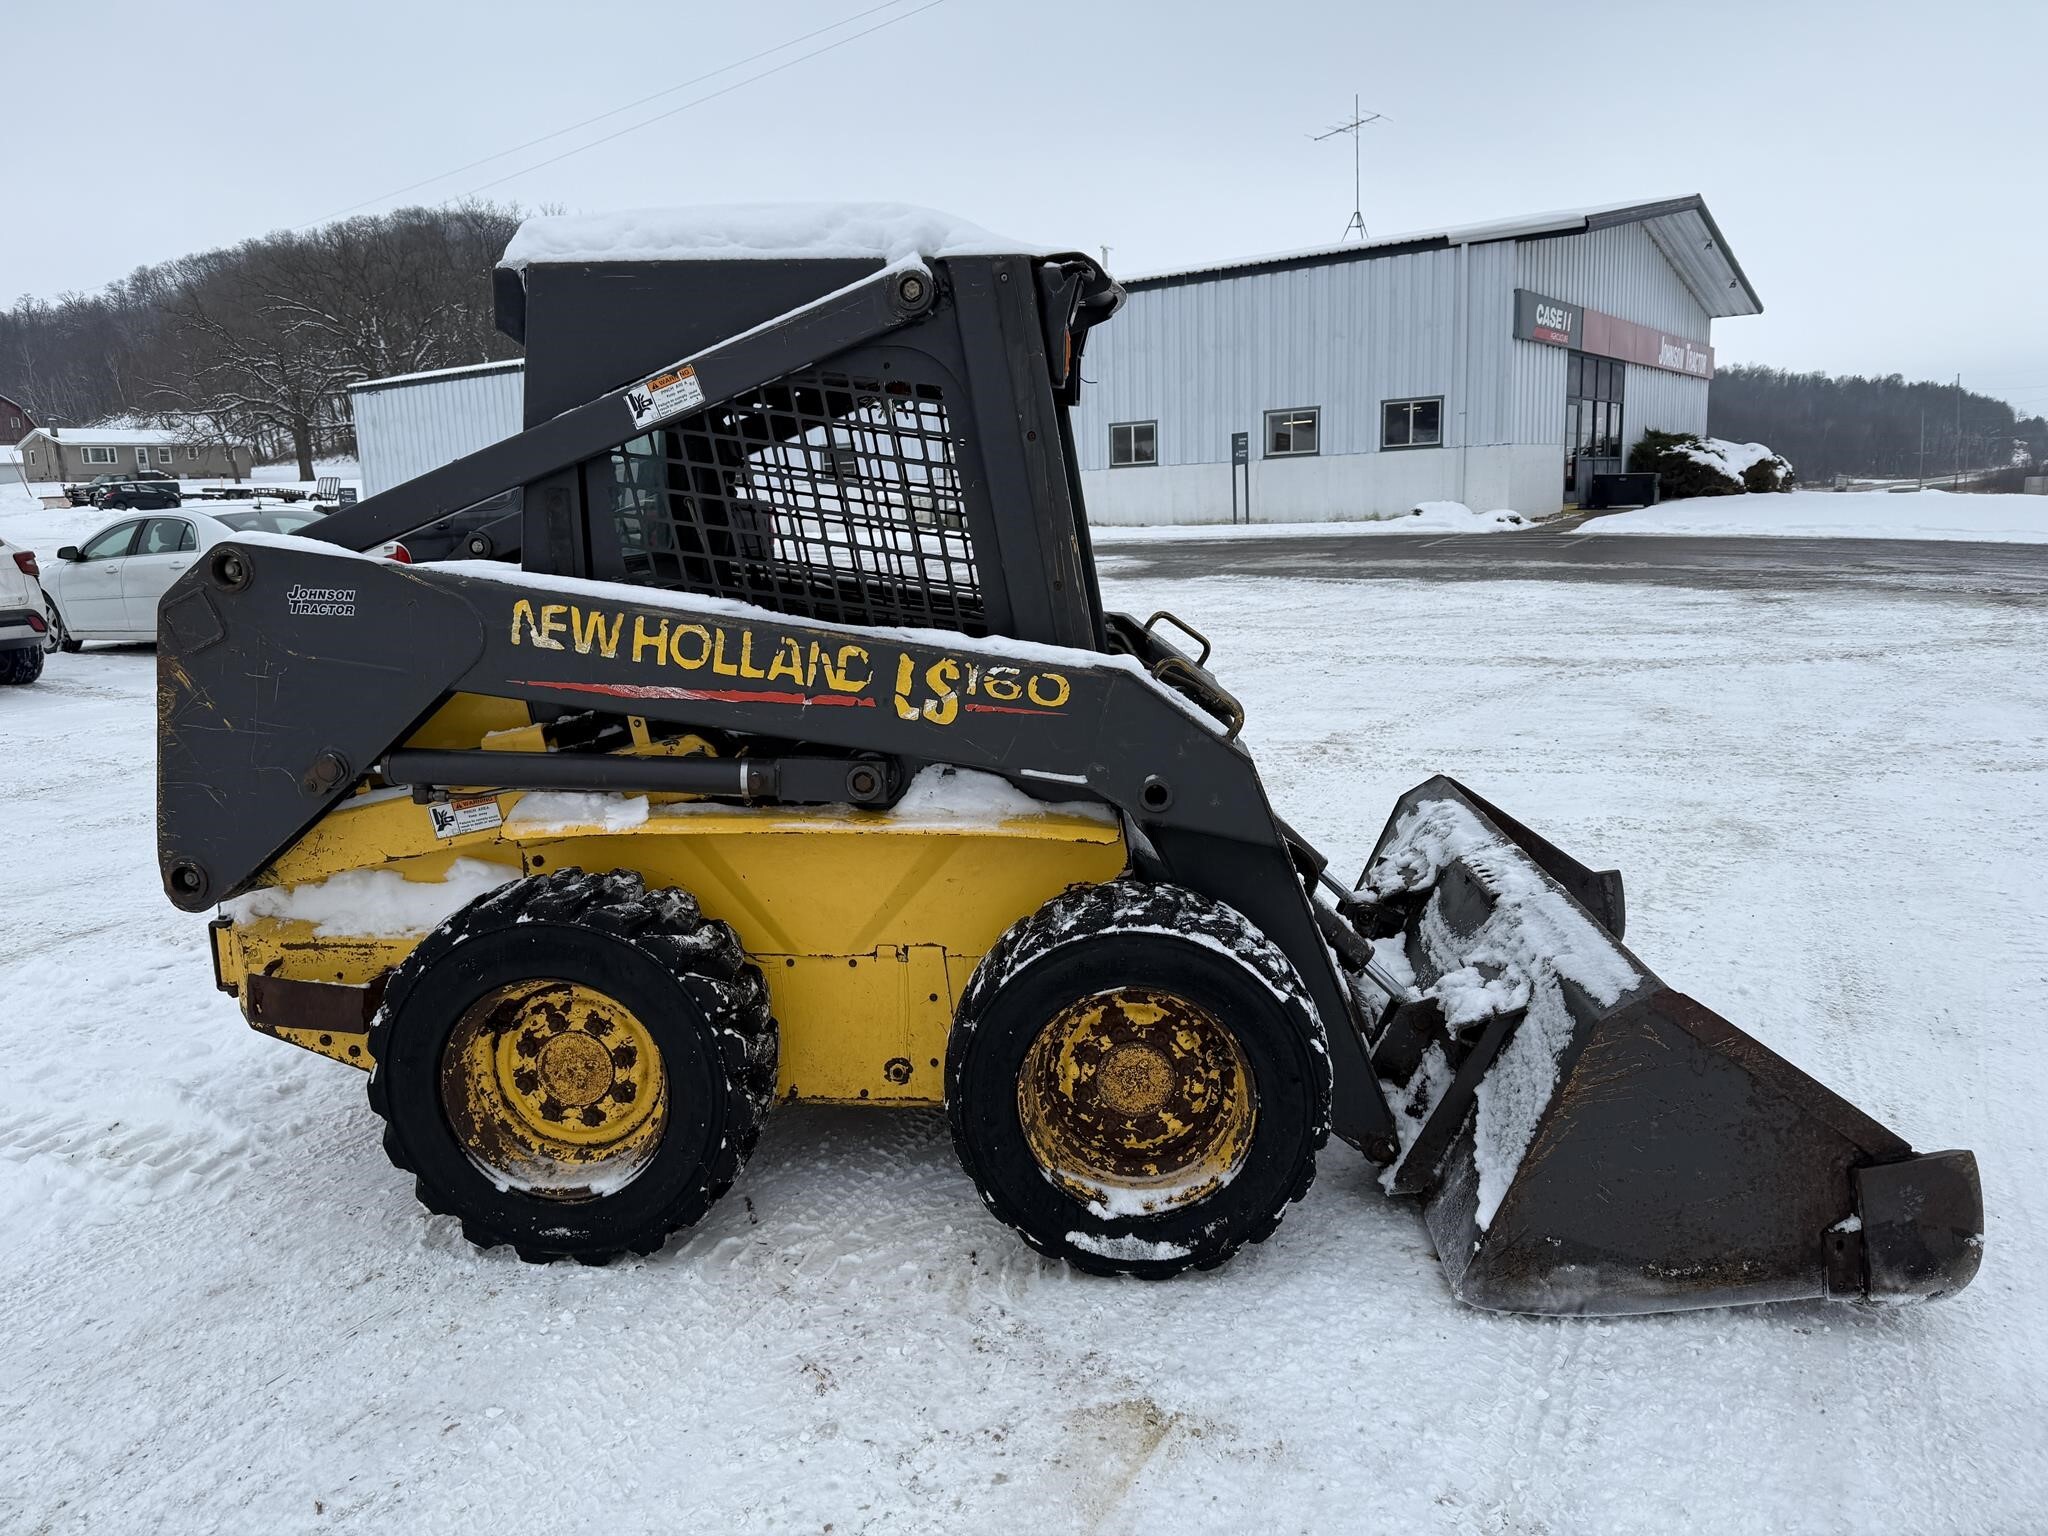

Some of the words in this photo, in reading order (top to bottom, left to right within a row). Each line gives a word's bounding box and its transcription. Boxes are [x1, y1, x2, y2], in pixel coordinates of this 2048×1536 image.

[1536, 304, 1563, 330] CASE
[287, 584, 356, 601] JOHNSON
[289, 599, 355, 616] TRACTOR
[511, 599, 625, 659] NEW
[632, 615, 874, 693] HOLLAND
